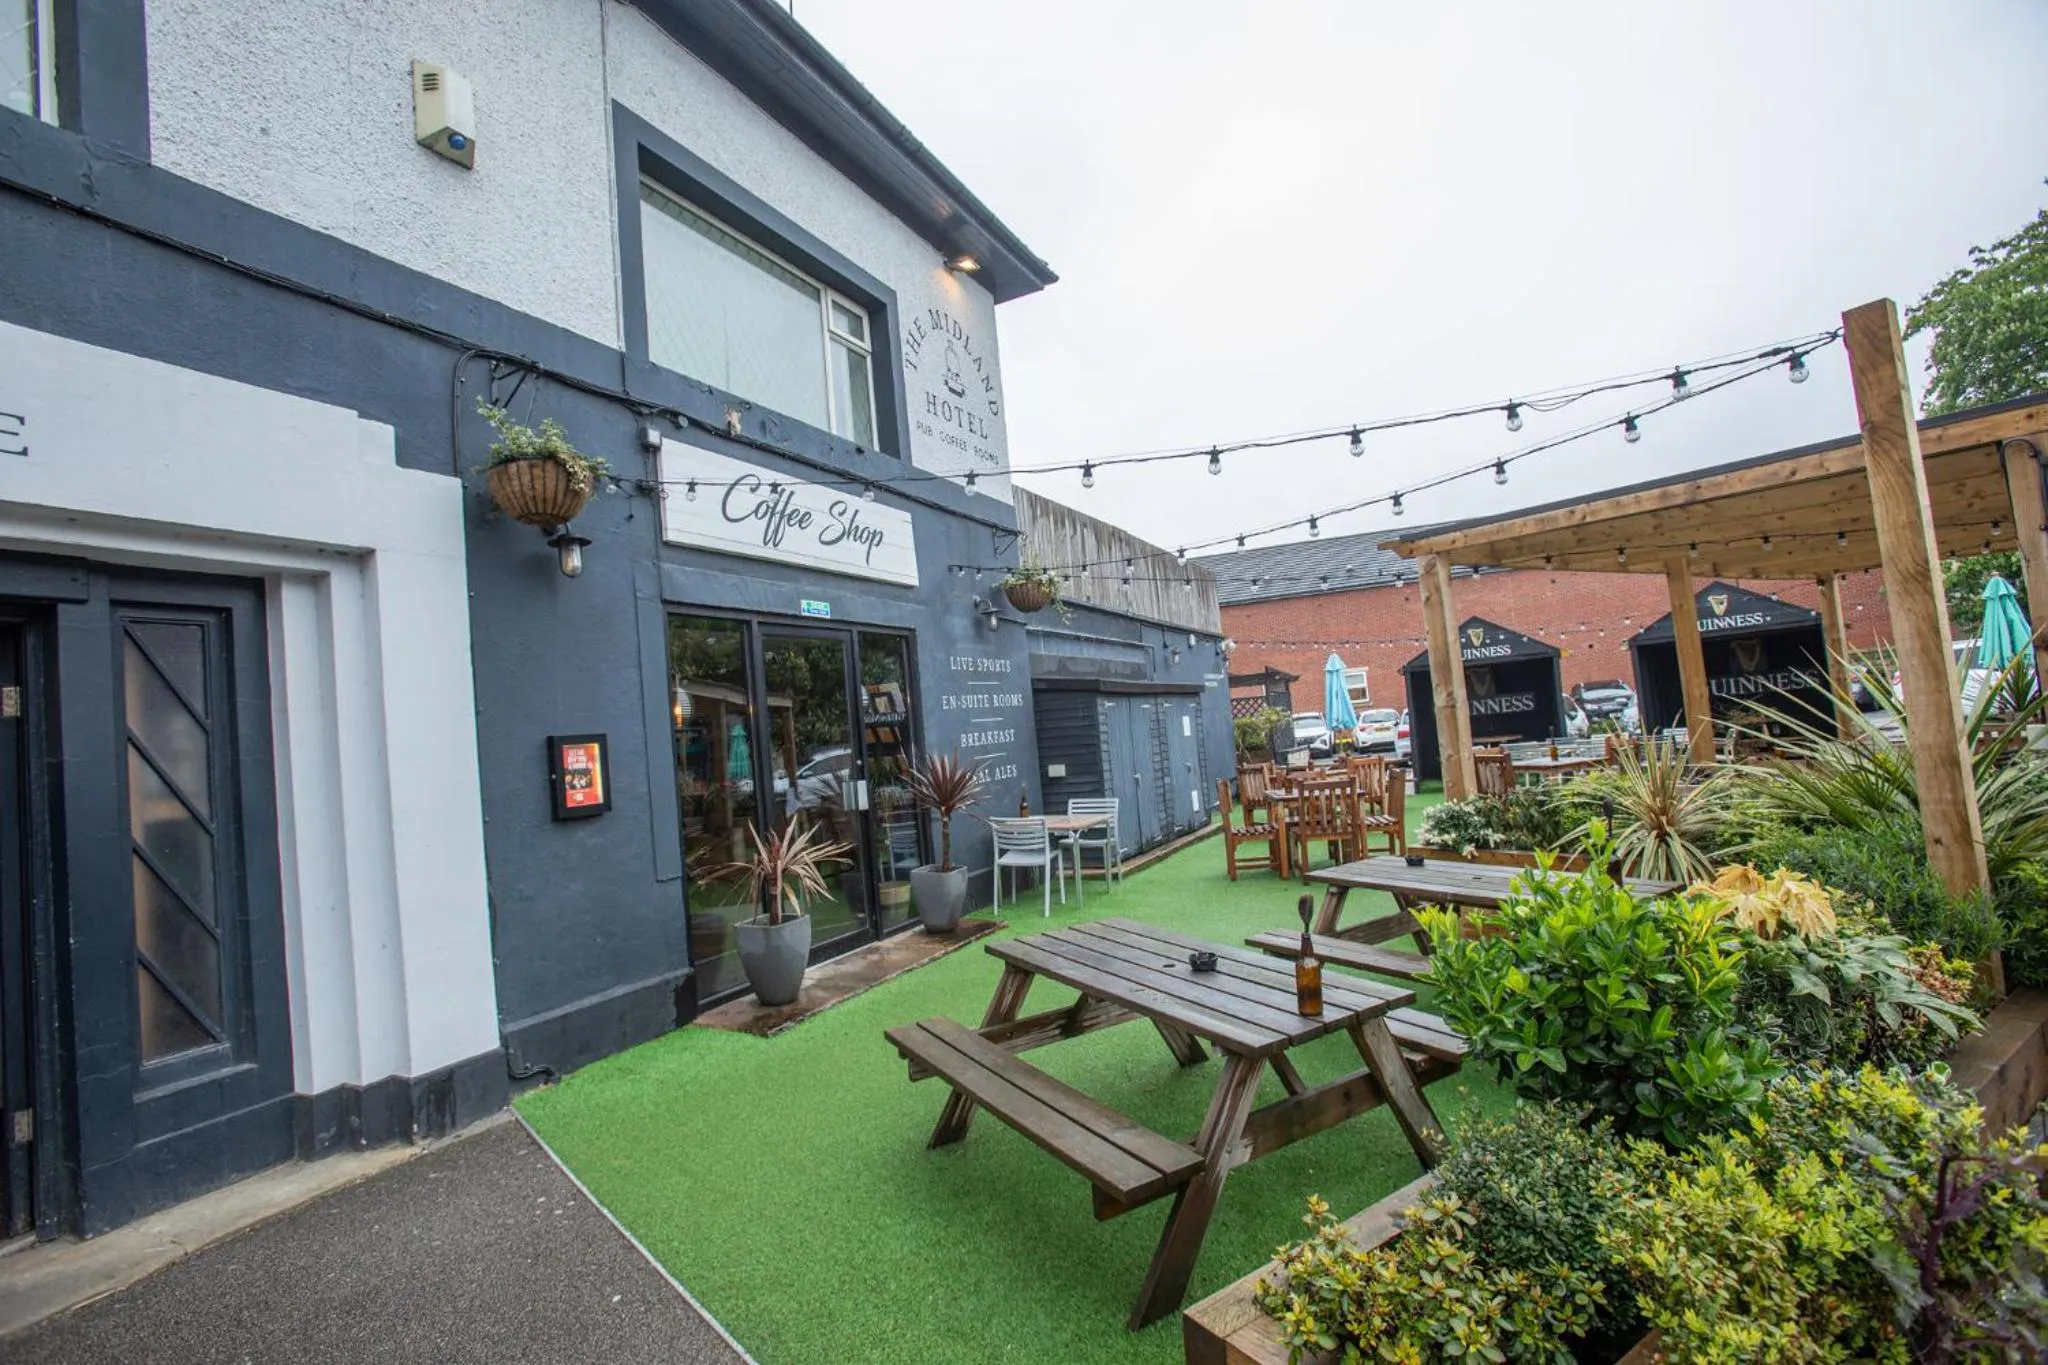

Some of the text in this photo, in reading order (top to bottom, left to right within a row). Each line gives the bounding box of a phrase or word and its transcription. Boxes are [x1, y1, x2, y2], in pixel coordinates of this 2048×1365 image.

[905, 308, 999, 416] THE MIDLAND
[925, 391, 988, 440] HOTEL
[722, 474, 885, 566] Coffee Shop
[1697, 612, 1764, 632] UINNESS
[950, 656, 1012, 673] LIVE SPORTS
[1710, 668, 1820, 696] UINNESS
[942, 693, 1024, 710] EN-SUITE ROOMS
[1472, 694, 1535, 716] NNESS
[960, 729, 1015, 747] BREAKFAST
[994, 764, 1018, 780] ALES
